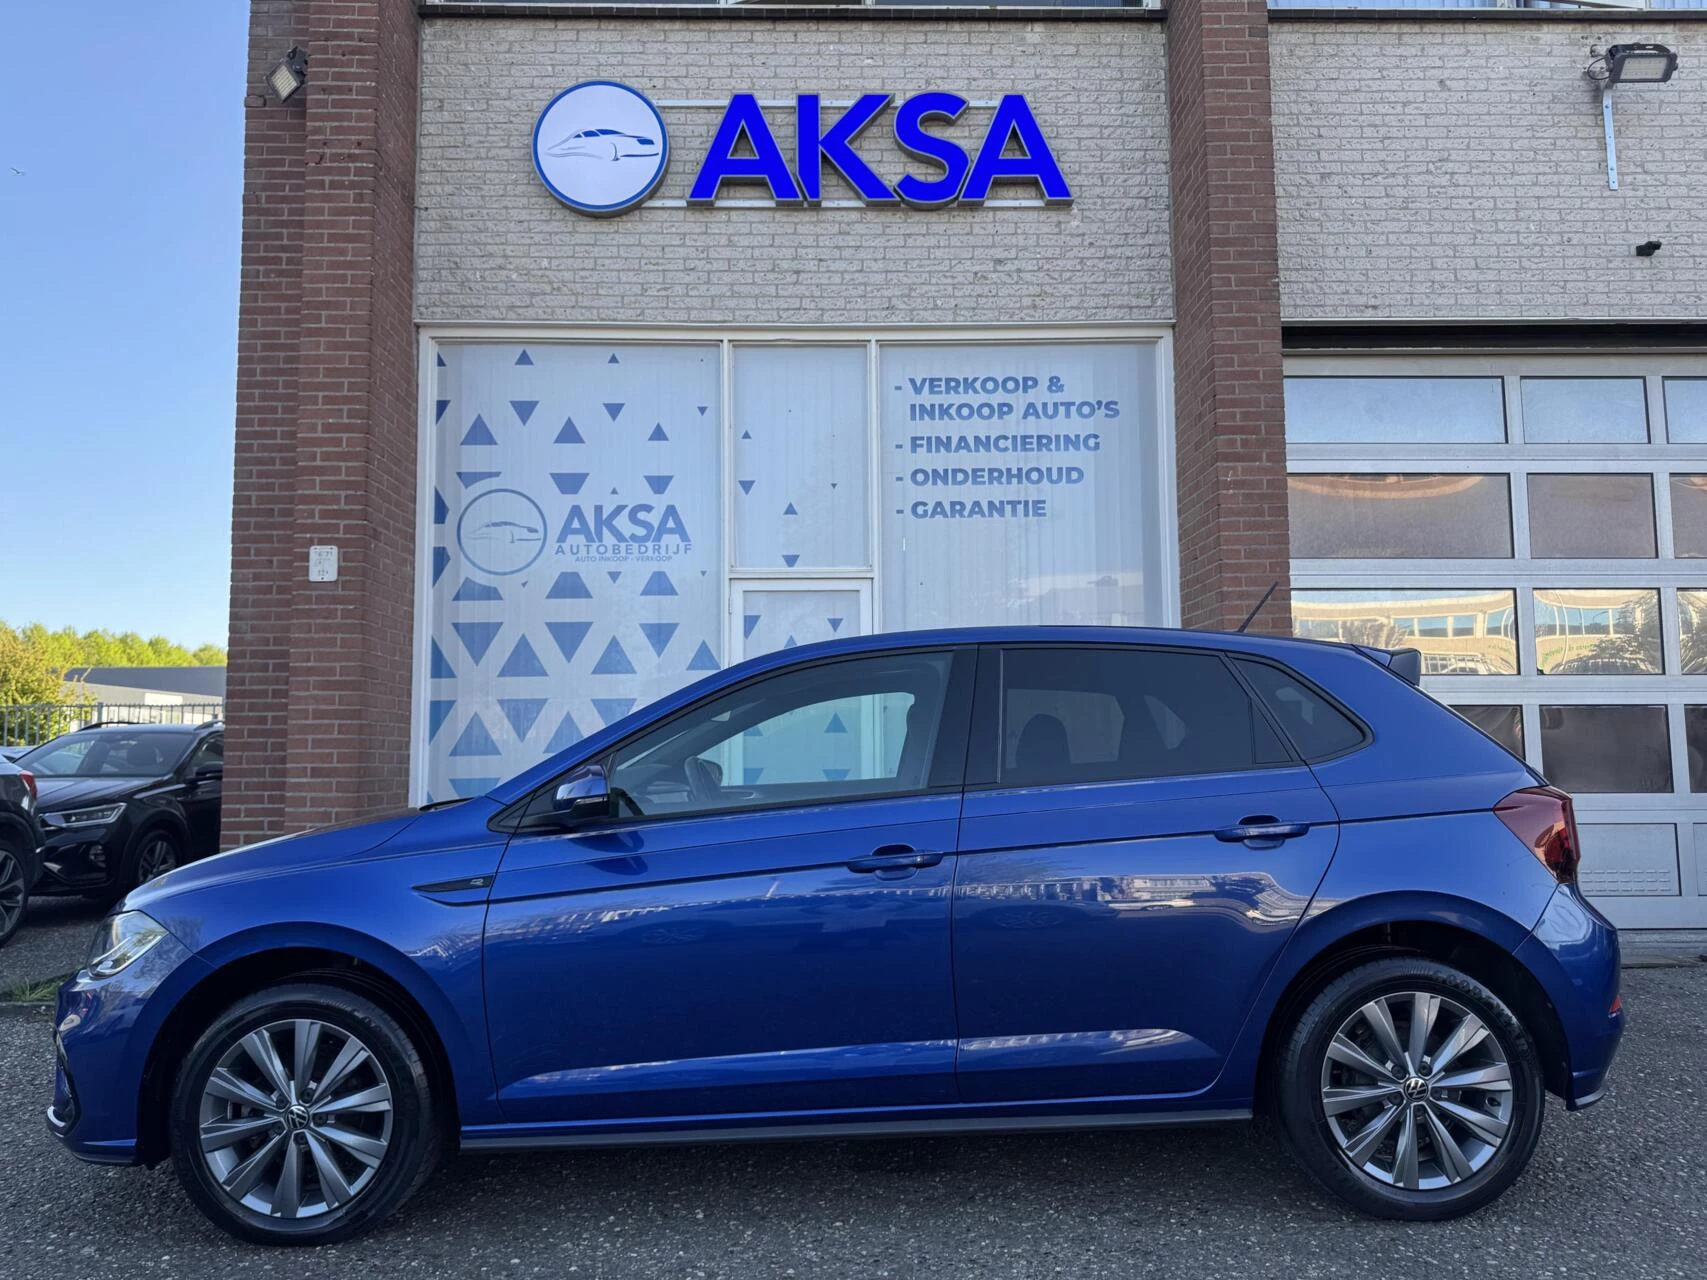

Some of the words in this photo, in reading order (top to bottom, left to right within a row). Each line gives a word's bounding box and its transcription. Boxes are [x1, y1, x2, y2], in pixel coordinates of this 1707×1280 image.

[687, 91, 1075, 207] AKSA
[908, 376, 1039, 395] VERKOOP
[1046, 375, 1065, 394] &
[909, 402, 1014, 421] INKOOP
[1021, 400, 1121, 420] AUTO'S
[909, 433, 1101, 454] FINANCIERING
[910, 467, 1085, 486] ONDERHOUD
[911, 500, 1047, 519] GARANTIE
[555, 503, 692, 544] AKSA
[554, 543, 693, 556] AUTOBEDRIJF
[575, 555, 598, 563] AUTO
[599, 555, 630, 563] INKOOP
